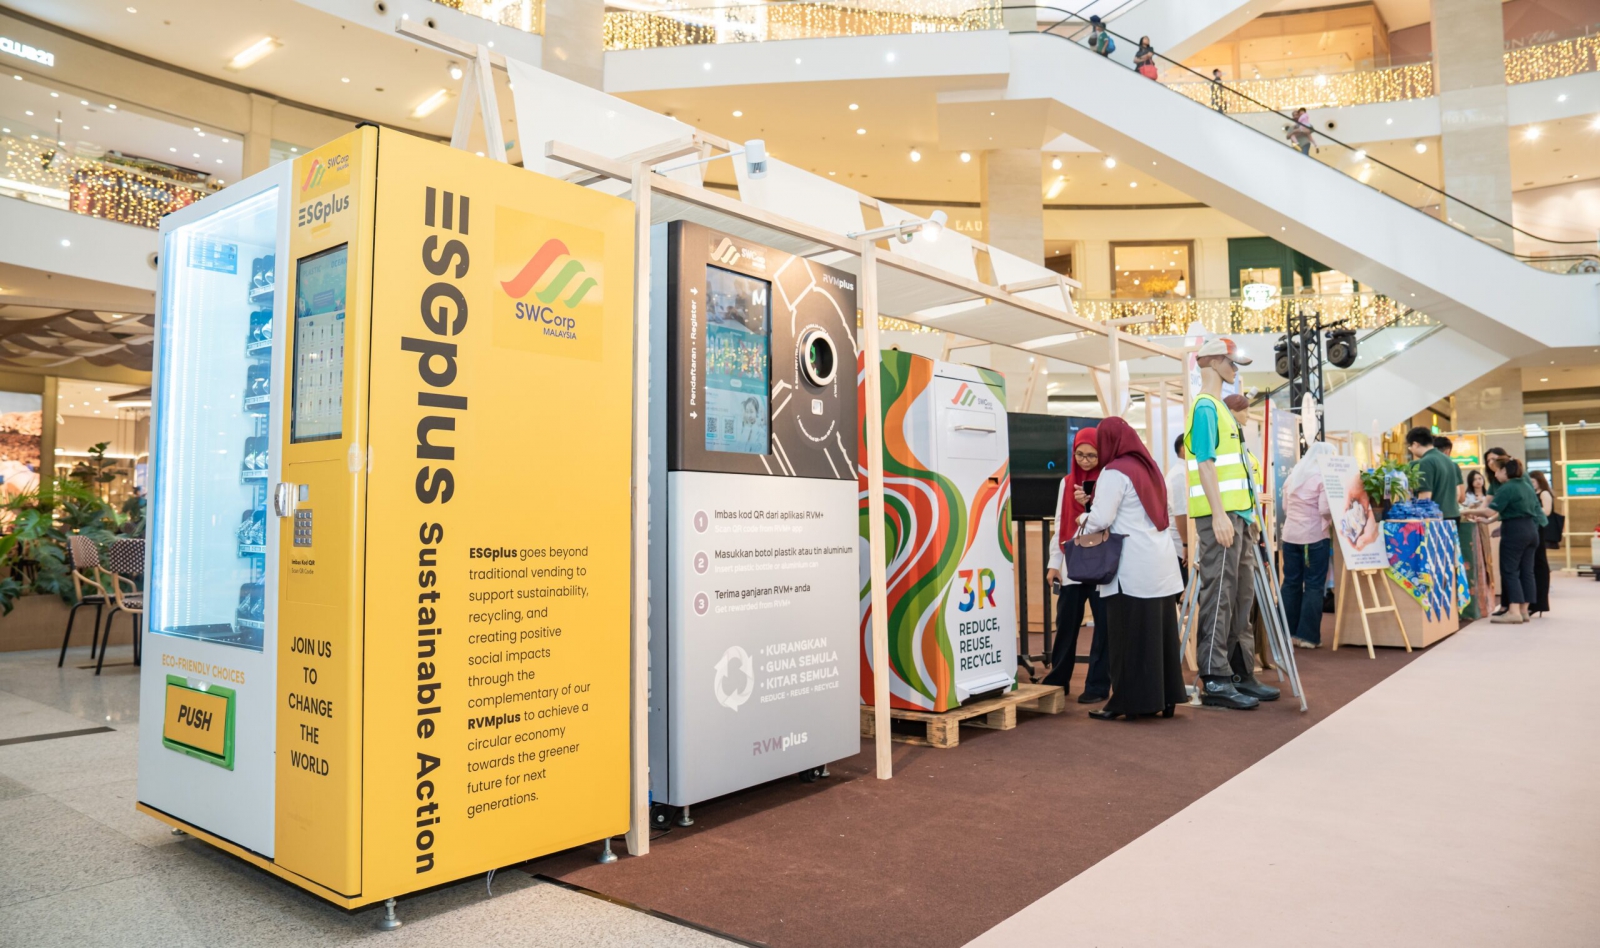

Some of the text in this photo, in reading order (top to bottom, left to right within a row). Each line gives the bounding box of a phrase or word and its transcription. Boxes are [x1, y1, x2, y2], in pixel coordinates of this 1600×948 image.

[298, 193, 350, 227] ESGplus
[955, 220, 983, 231] LAU
[823, 273, 854, 291] RVMplus
[515, 301, 576, 330] SWCorp
[543, 327, 577, 340] MALAYSIA
[401, 186, 470, 504] ESGplus
[690, 299, 698, 406] Pendaftaran Register
[698, 516, 704, 527] 1
[714, 510, 824, 521] Imbas kod QR dari aplikasi RVM+
[469, 546, 588, 562] ESGplus goes beyond
[698, 557, 705, 568] 2
[714, 546, 853, 559] Masukkan botol plastik atau tin aluminium
[469, 566, 587, 580] traditional vending to
[469, 585, 589, 604] support sustainability,
[715, 583, 811, 599] Terima ganjaran RVM+ anda
[958, 568, 996, 613] 3R
[698, 599, 705, 609] 3
[715, 604, 728, 614] Get
[728, 601, 759, 612] rewarded
[759, 600, 773, 610] from
[468, 607, 548, 624] recycling, and
[468, 626, 562, 645] creating positive
[959, 617, 1000, 636] REDUCE,
[291, 636, 332, 658] JOIN US
[766, 637, 827, 656] KURANGKAN
[960, 635, 993, 654] REUSE,
[468, 648, 551, 666] social impacts
[766, 651, 838, 673] GUNA SEMULA
[960, 650, 1002, 671] RECYCLE
[162, 654, 245, 685] ECO-FRIENDLY CHOICES
[303, 667, 318, 685] TO
[468, 670, 535, 687] through the
[766, 666, 839, 689] KITAR SEMULA
[416, 521, 444, 874] Sustainable Action
[468, 683, 591, 709] complementary of our
[760, 680, 839, 703] REDUCE REUSE RECYCLE
[288, 692, 333, 719] CHANGE
[177, 704, 213, 731] PUSH
[467, 702, 589, 730] RVMplus to achieve a
[300, 724, 319, 744] THE
[467, 725, 566, 751] circular economy
[753, 731, 808, 756] RVMplus
[290, 750, 329, 777] WORLD
[467, 742, 580, 773] towards the greener
[467, 768, 546, 793] future for next
[467, 790, 539, 819] generations.
